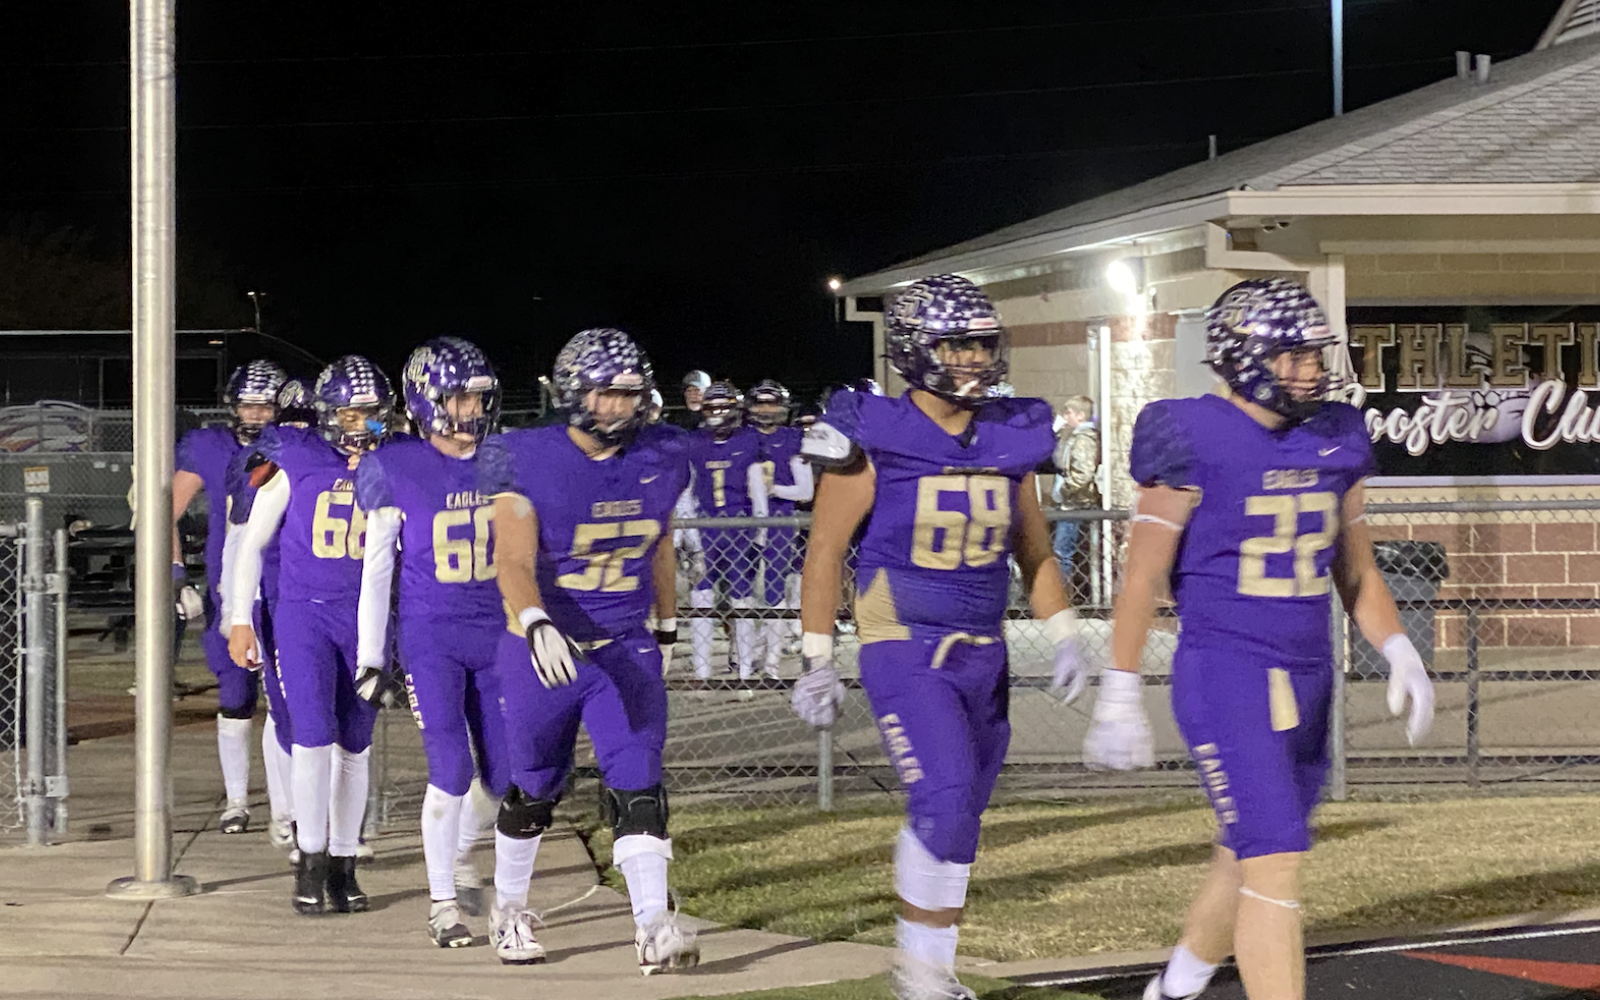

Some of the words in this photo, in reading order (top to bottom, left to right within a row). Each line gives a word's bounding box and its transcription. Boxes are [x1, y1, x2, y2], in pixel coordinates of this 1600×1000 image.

[554, 519, 660, 592] 52
[911, 474, 1010, 570] 68
[1237, 492, 1338, 597] 22
